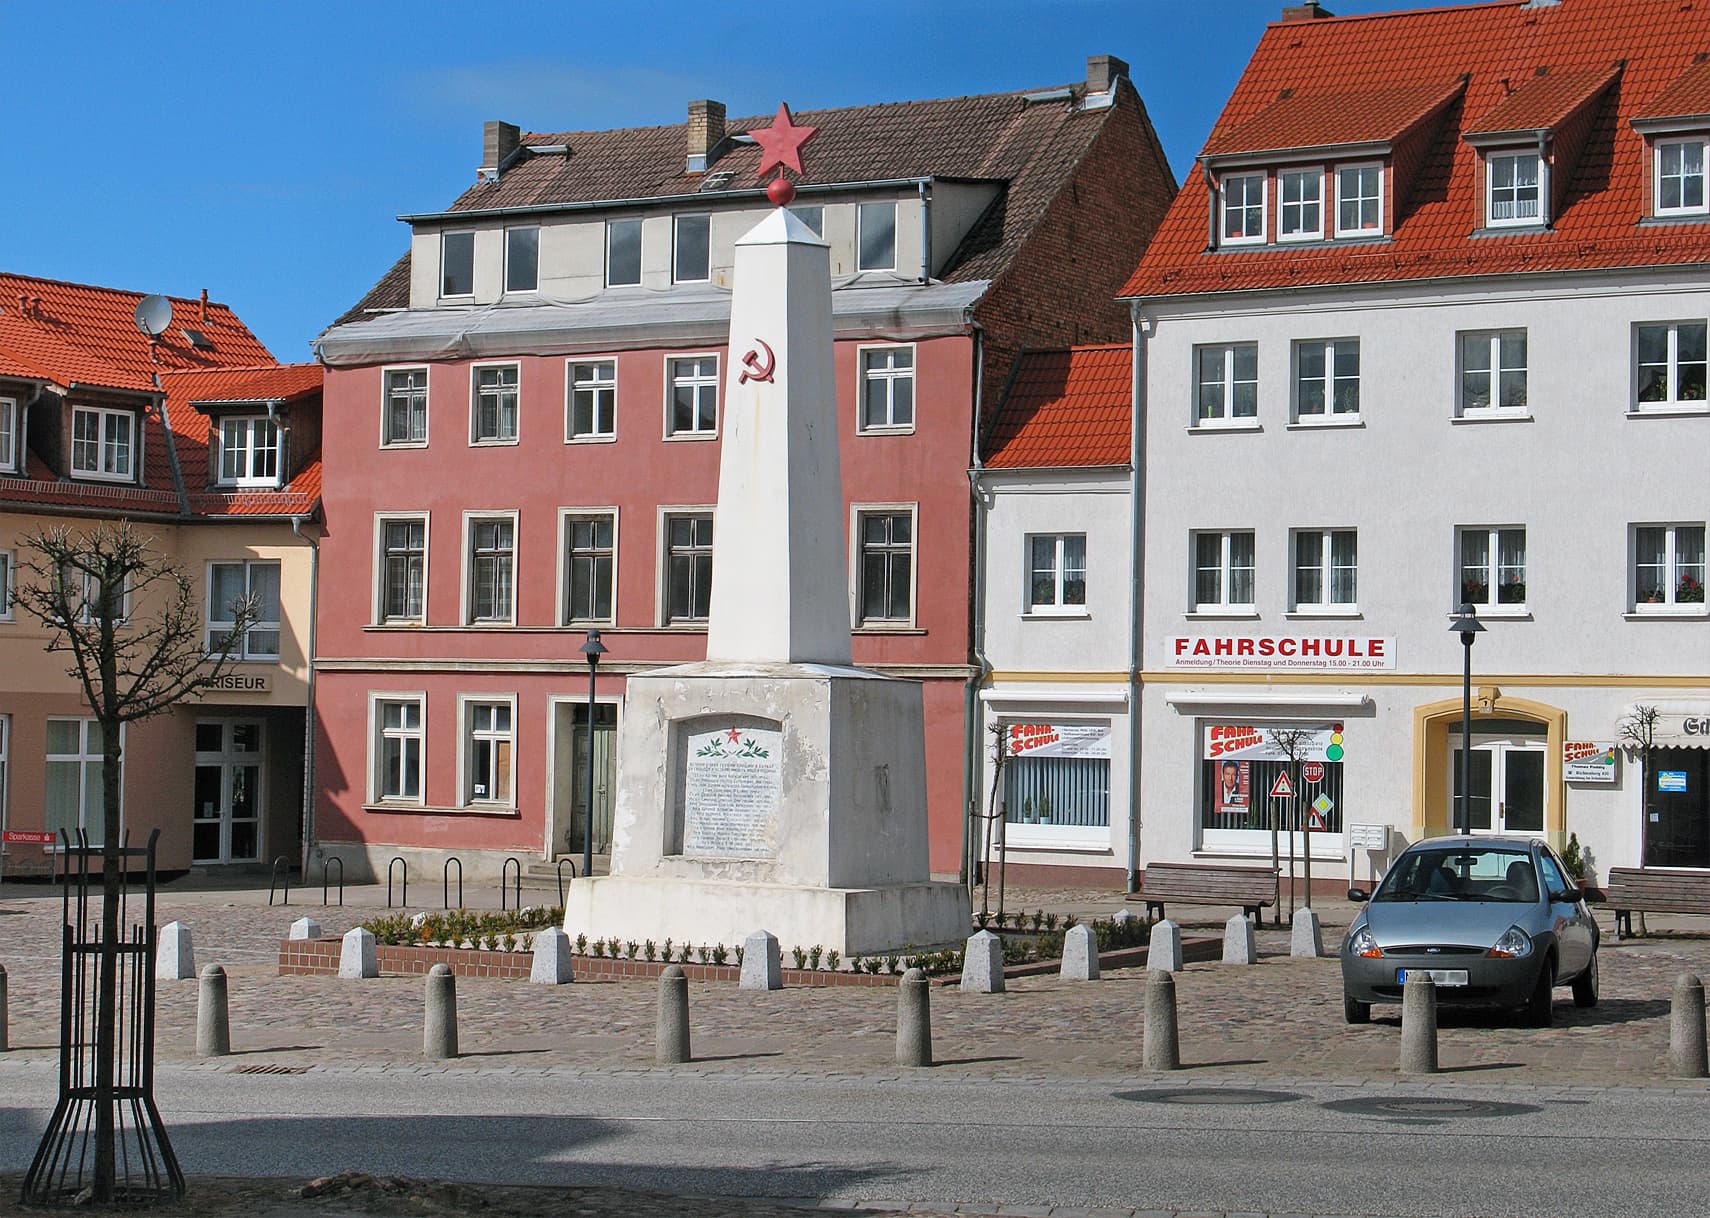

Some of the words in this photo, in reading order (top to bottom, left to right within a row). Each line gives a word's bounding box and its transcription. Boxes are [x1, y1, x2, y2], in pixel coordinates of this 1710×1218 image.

[1175, 638, 1384, 657] FAHRSCHULE
[1242, 659, 1271, 667] Dienstag
[1288, 659, 1327, 668] Donnerstag
[1352, 660, 1370, 668] 21.00
[1372, 660, 1384, 668] Uhr
[1012, 724, 1055, 739] FAHR-
[1211, 725, 1258, 740] FAHR-
[1011, 733, 1059, 755] SCHULE
[1210, 735, 1263, 757] SCHULE
[1564, 742, 1597, 752] FAHR-
[1564, 748, 1600, 763] SCHULE
[1304, 766, 1323, 776] STOP
[8, 832, 41, 841] Sparkasse
